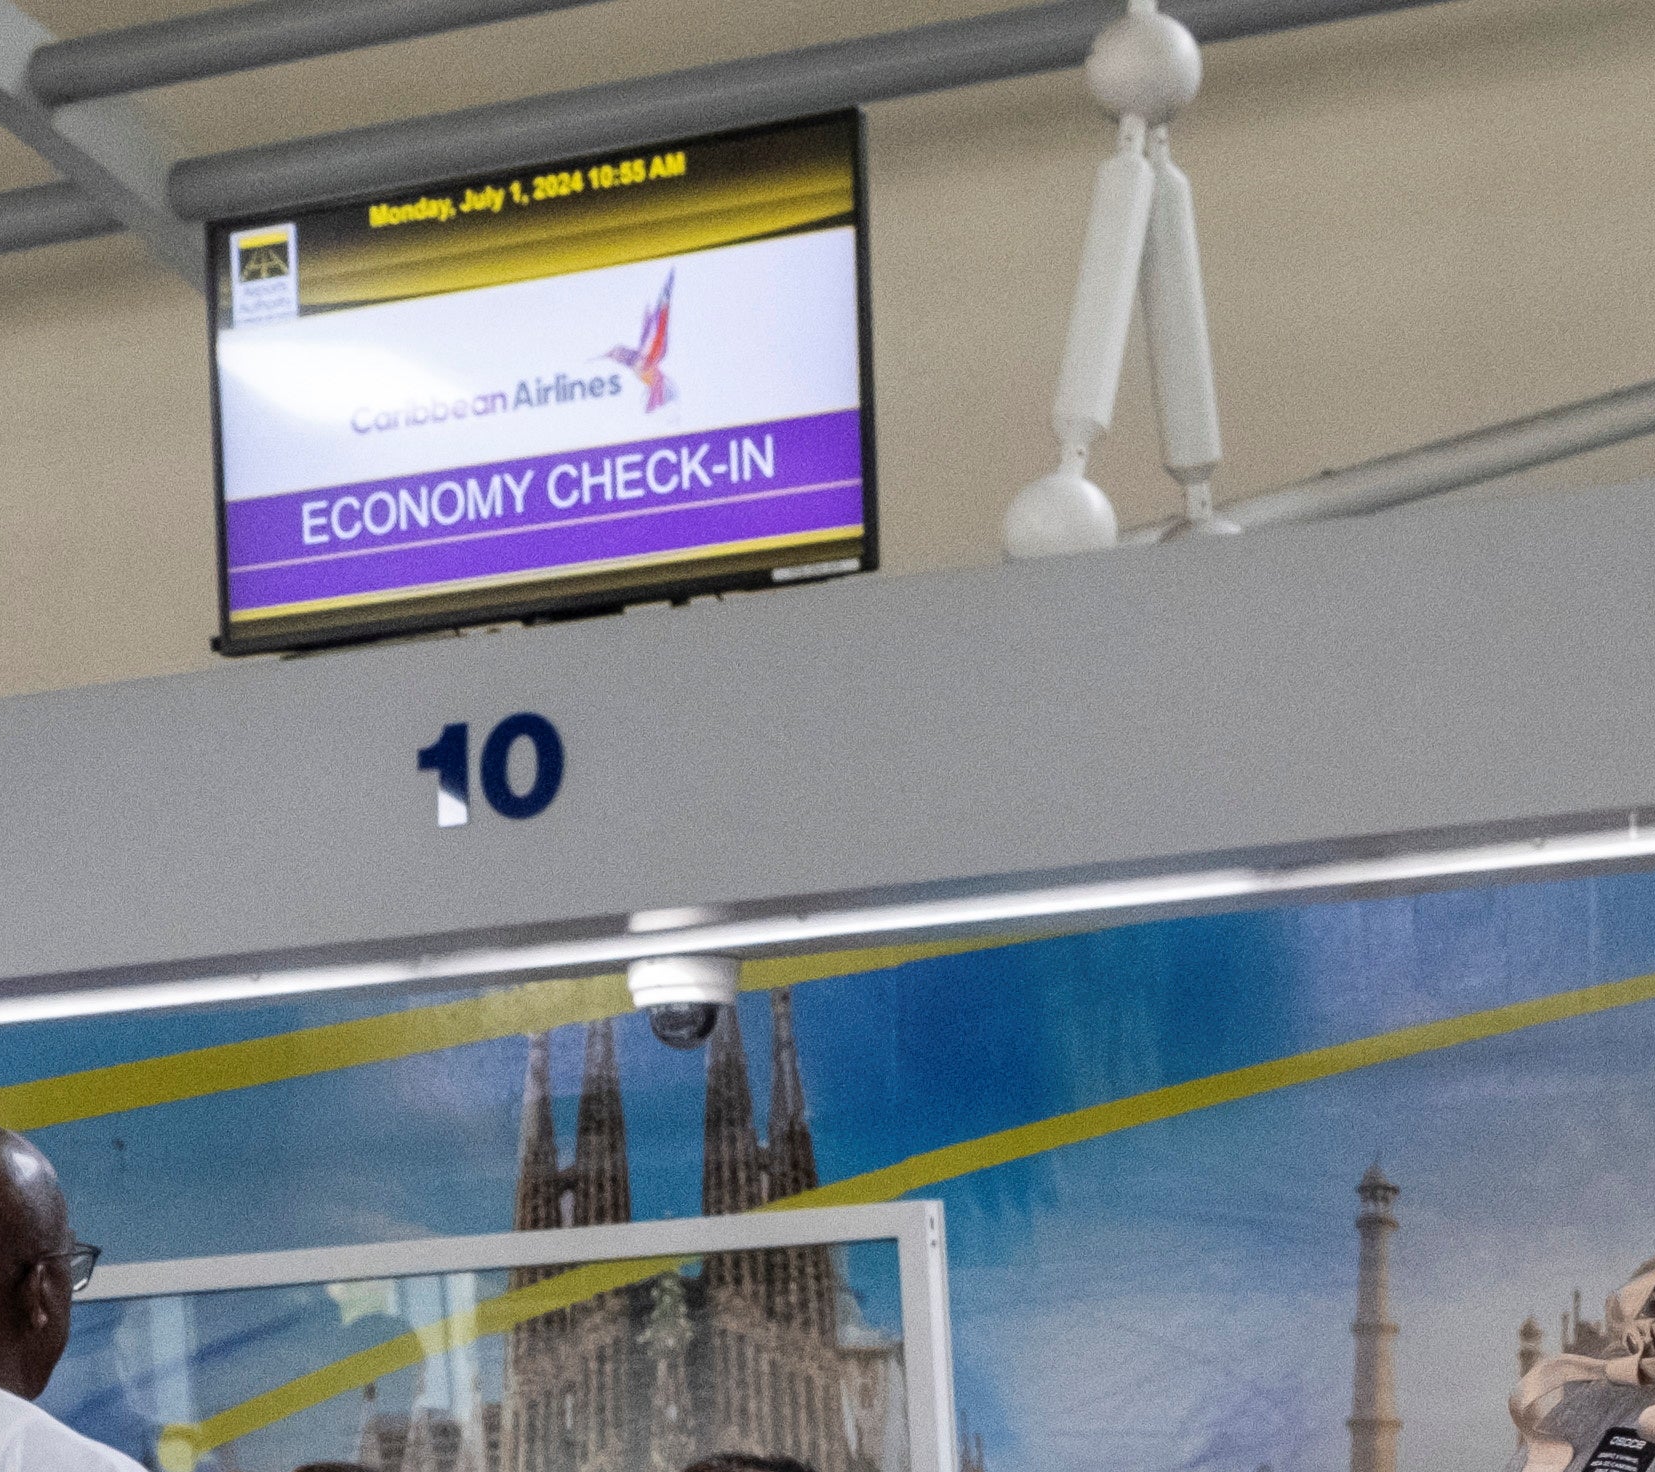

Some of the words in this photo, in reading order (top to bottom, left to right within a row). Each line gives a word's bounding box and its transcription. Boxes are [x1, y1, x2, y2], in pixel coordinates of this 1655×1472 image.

[369, 198, 457, 227] Monday,
[459, 185, 506, 213] July
[509, 180, 530, 206] 1,
[532, 169, 585, 201] 2024
[588, 158, 647, 190] 10:55
[648, 151, 686, 179] AM
[349, 390, 509, 435] Caribbean
[512, 373, 623, 410] Airlines
[301, 469, 534, 545] ECONOMY
[546, 434, 776, 509] CHECK-IN
[417, 712, 566, 828] 10
